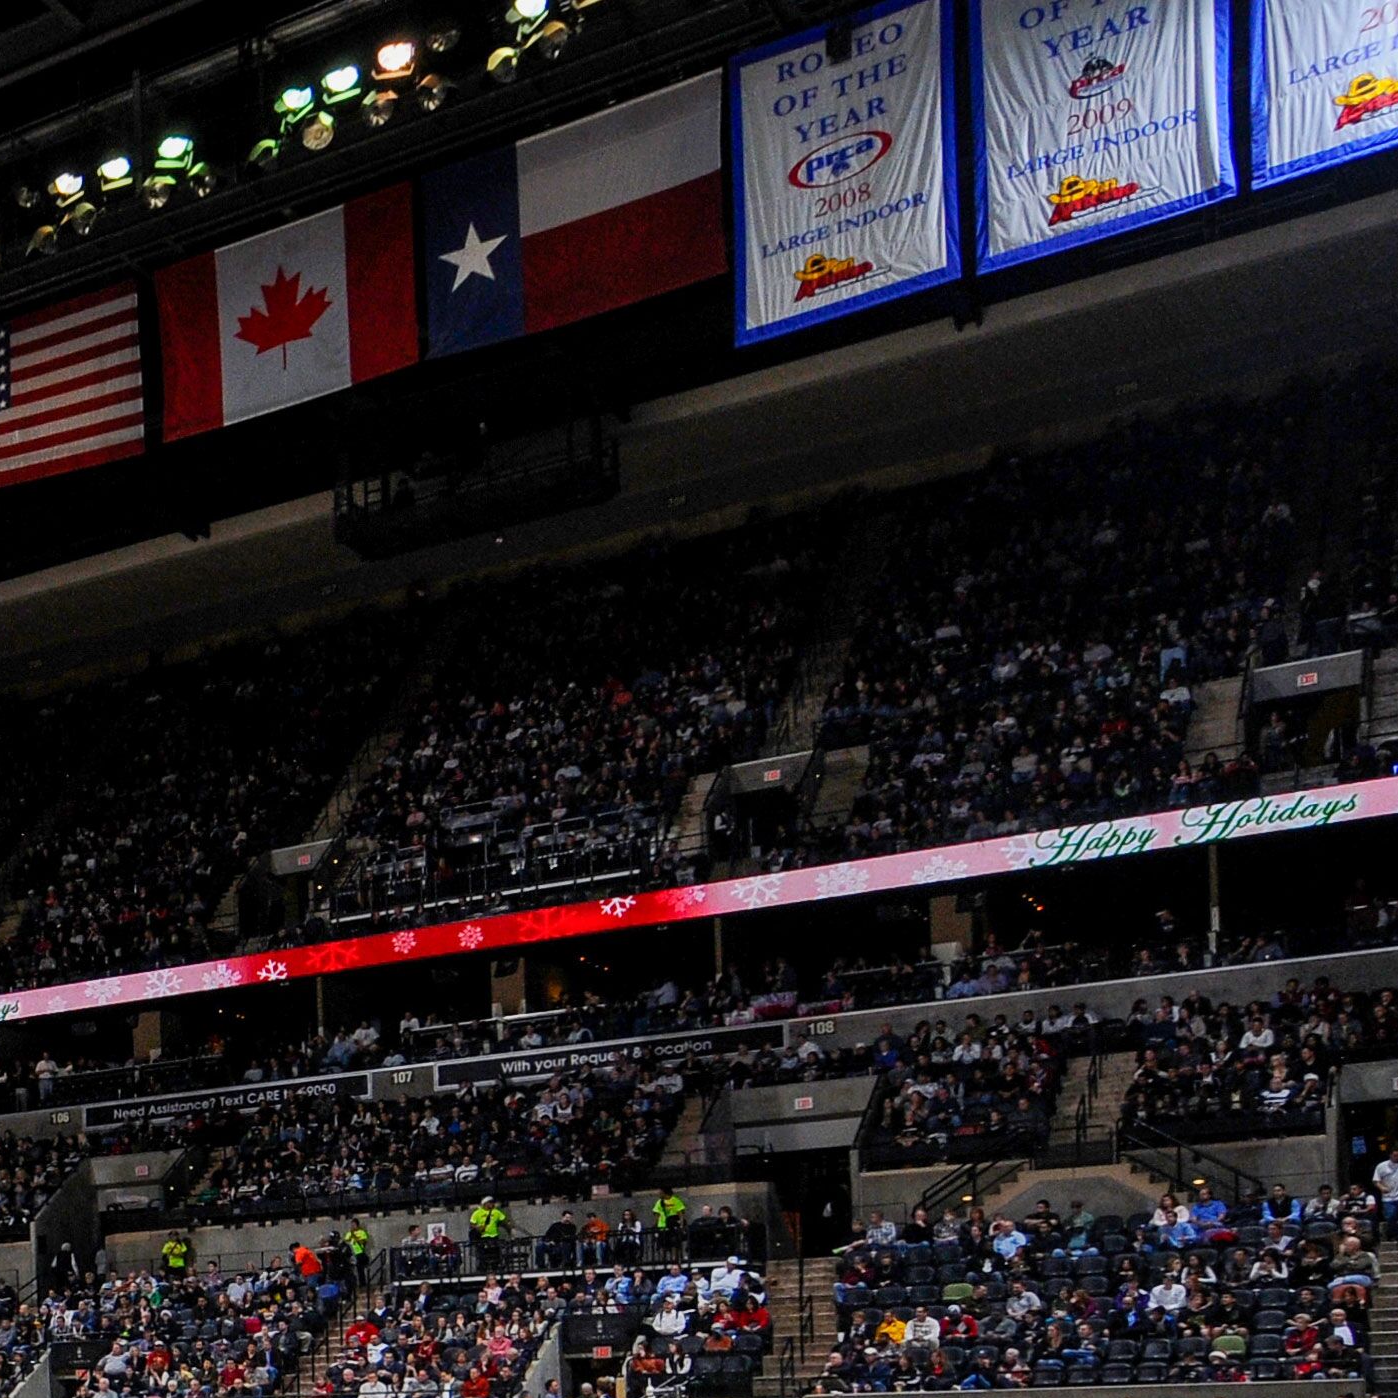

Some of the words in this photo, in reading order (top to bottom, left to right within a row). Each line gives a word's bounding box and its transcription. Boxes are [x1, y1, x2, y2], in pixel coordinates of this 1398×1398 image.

[1041, 5, 1151, 58] YEAR
[777, 22, 903, 85] ROEO
[773, 86, 819, 118] OF
[831, 53, 908, 98] THE
[794, 96, 886, 144] YEAR
[1067, 98, 1132, 136] 2009
[1005, 143, 1085, 181] LARGE
[1092, 108, 1199, 157] INDOOR
[813, 182, 872, 219] 2008
[760, 226, 831, 260] LARGE
[836, 191, 927, 235] INDOOR
[1029, 823, 1158, 869] Happy
[1174, 793, 1359, 846] Holidays
[808, 1020, 836, 1035] 108
[391, 1071, 413, 1084] 107
[500, 1061, 530, 1075] With
[532, 1058, 567, 1076] your
[50, 1110, 71, 1124] 106
[113, 1105, 147, 1120] Need
[148, 1097, 218, 1116] Assistance?
[219, 1094, 245, 1107] Text
[246, 1089, 281, 1105] CARE
